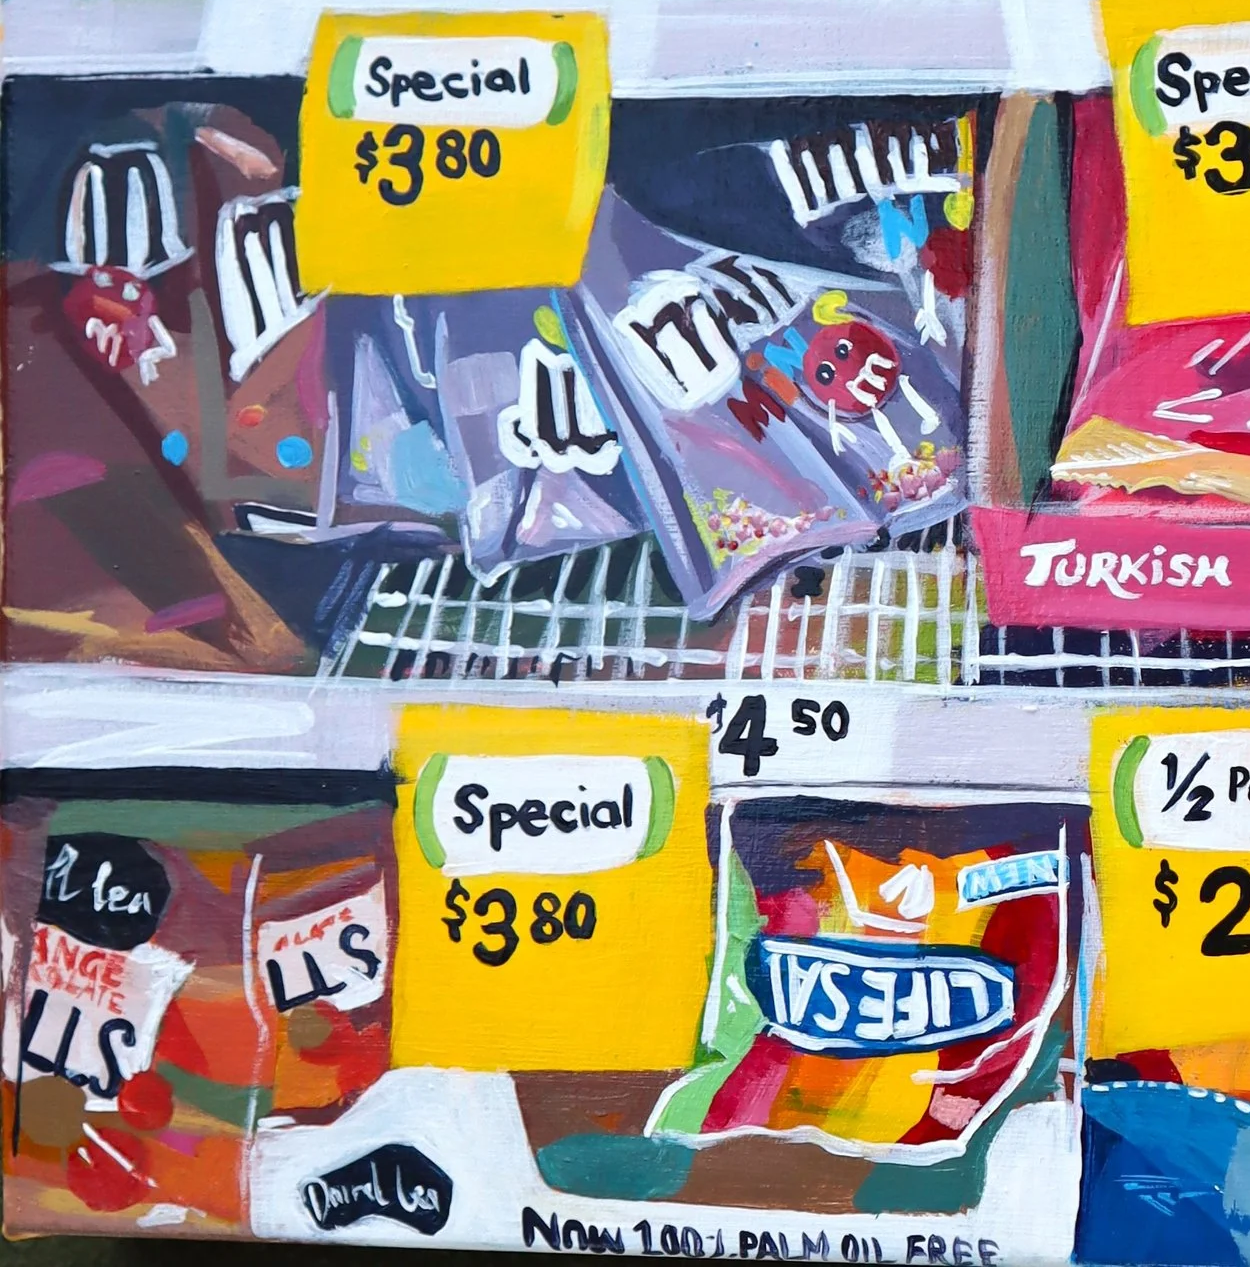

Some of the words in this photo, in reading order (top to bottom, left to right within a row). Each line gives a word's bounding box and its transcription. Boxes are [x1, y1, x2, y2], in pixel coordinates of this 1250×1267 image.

[366, 56, 530, 106] Special
[453, 783, 634, 852] Special
[738, 1229, 830, 1262] PALM
[841, 1233, 897, 1263] OIL
[907, 1234, 1001, 1267] FREE
